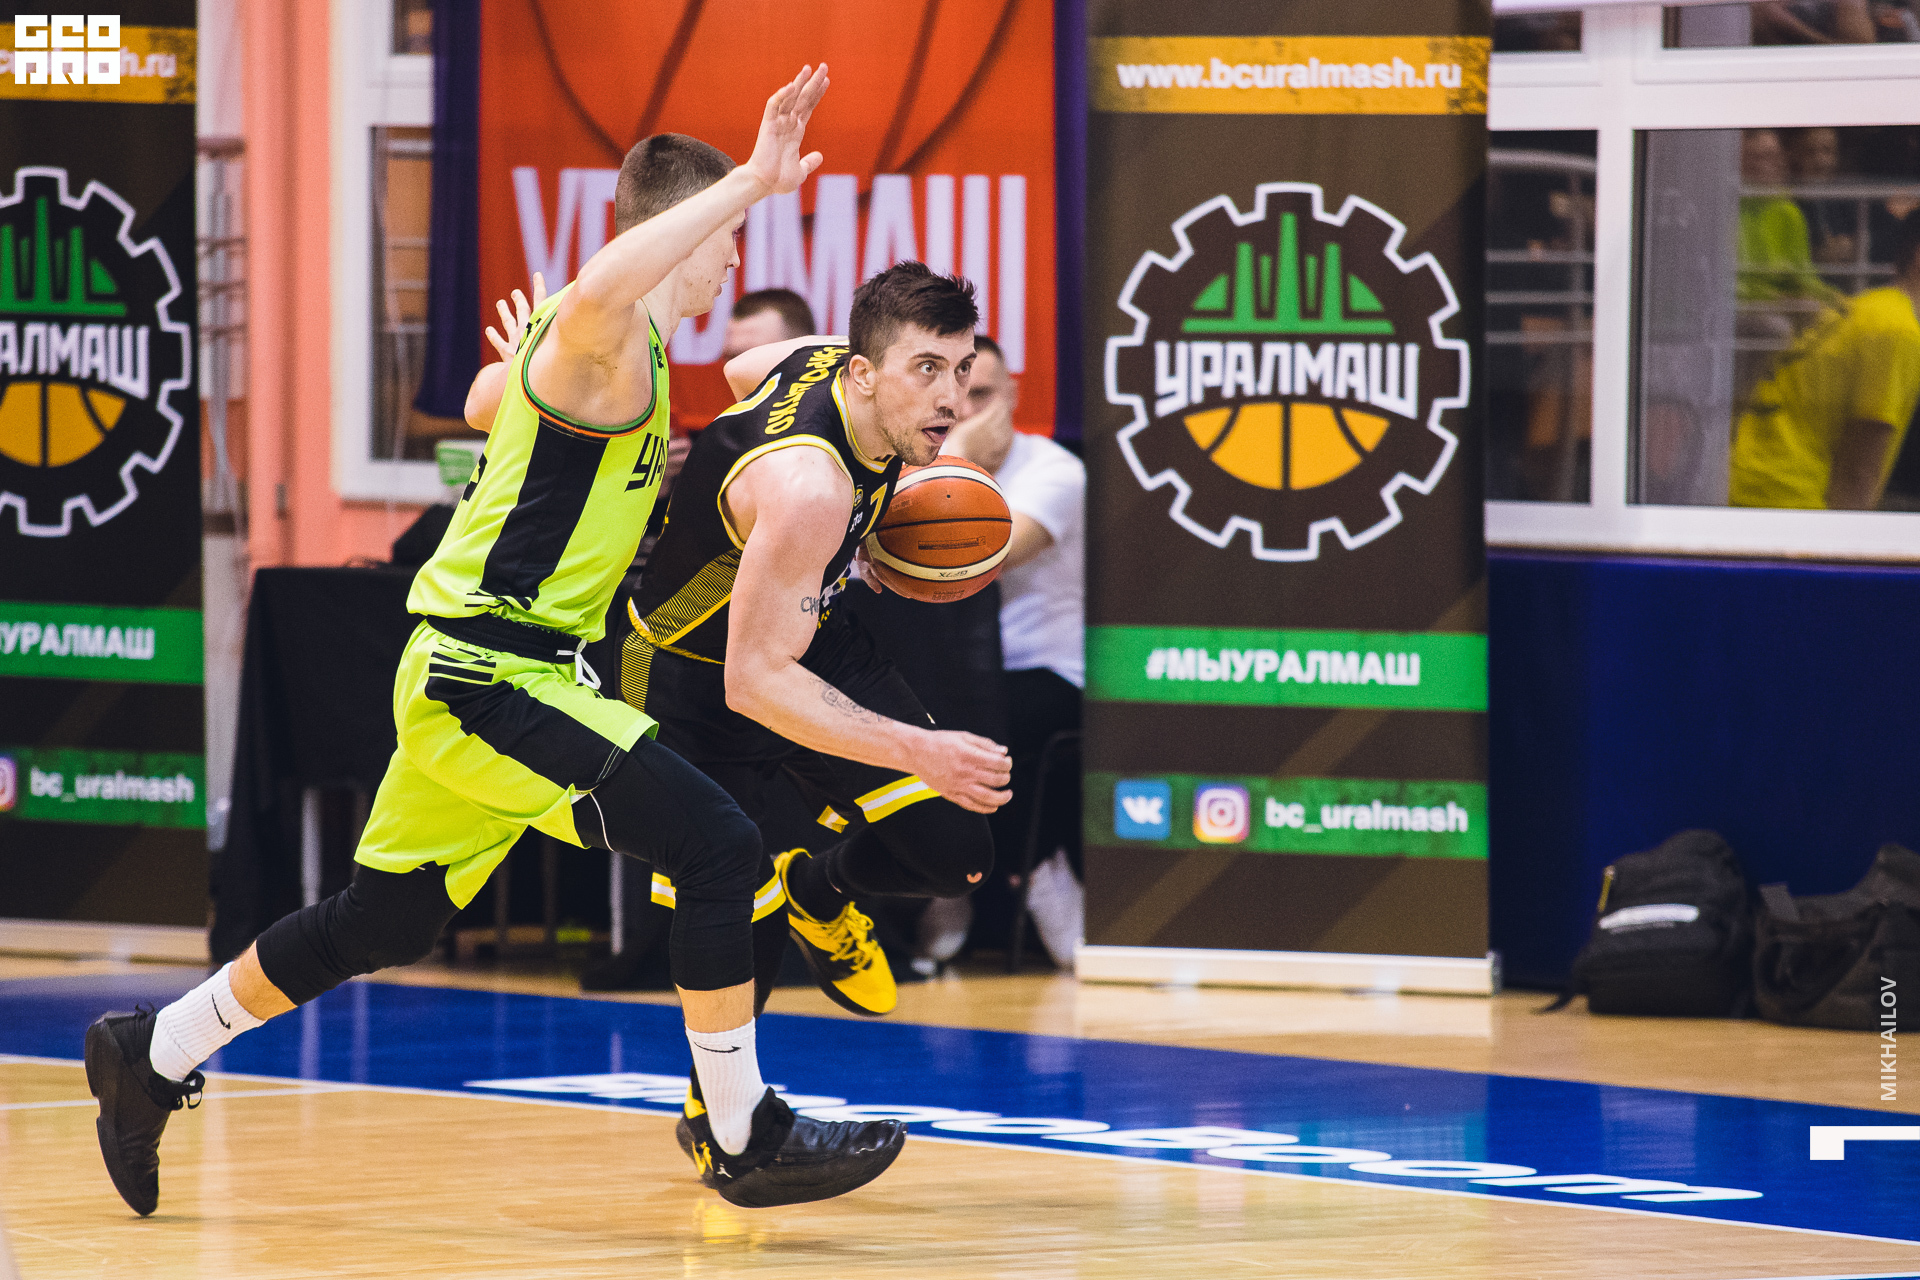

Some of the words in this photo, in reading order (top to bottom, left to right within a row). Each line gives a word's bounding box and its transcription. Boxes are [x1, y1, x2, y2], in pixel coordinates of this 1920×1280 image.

[1116, 57, 1462, 89] www.bcuralmash.ru
[1154, 341, 1420, 419] УРАЛМАШ
[860, 483, 888, 540] 7
[0, 621, 155, 660] УРАЛМАШ
[1146, 647, 1421, 686] #МЫУРАЛМАШ
[30, 766, 195, 803] bc_uralmash
[1265, 797, 1468, 833] bc_uralmash
